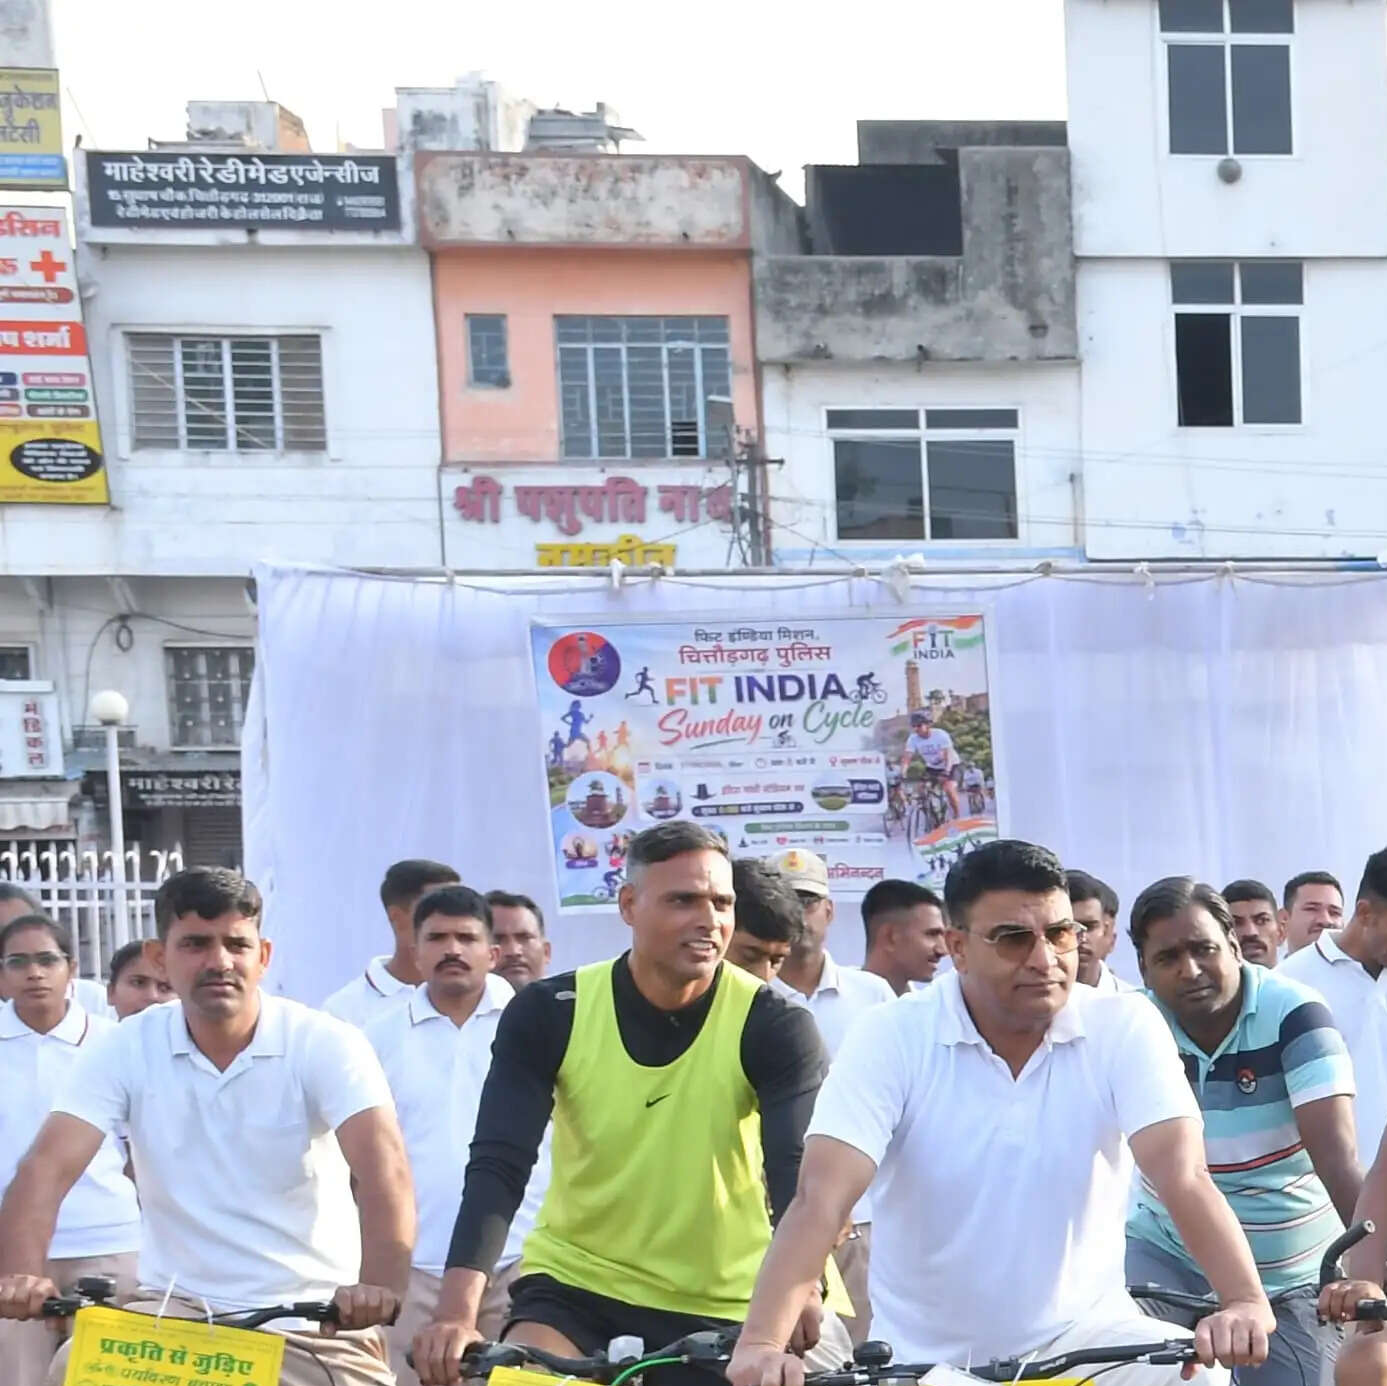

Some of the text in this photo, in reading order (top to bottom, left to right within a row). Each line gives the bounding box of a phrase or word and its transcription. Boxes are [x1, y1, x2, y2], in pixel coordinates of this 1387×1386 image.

[103, 156, 380, 186] माहेश्वरी रेडीमेड एजेन्सीज
[454, 476, 502, 523] श्री
[514, 476, 647, 536] पशुपति
[913, 628, 954, 649] FIT
[777, 642, 831, 667] पुलिस
[914, 649, 955, 660] INDIA
[666, 674, 850, 705] FIT INDIA
[658, 701, 874, 746] Sunday on Cycle
[100, 1338, 254, 1376] प्रकृति से जुड़िए
